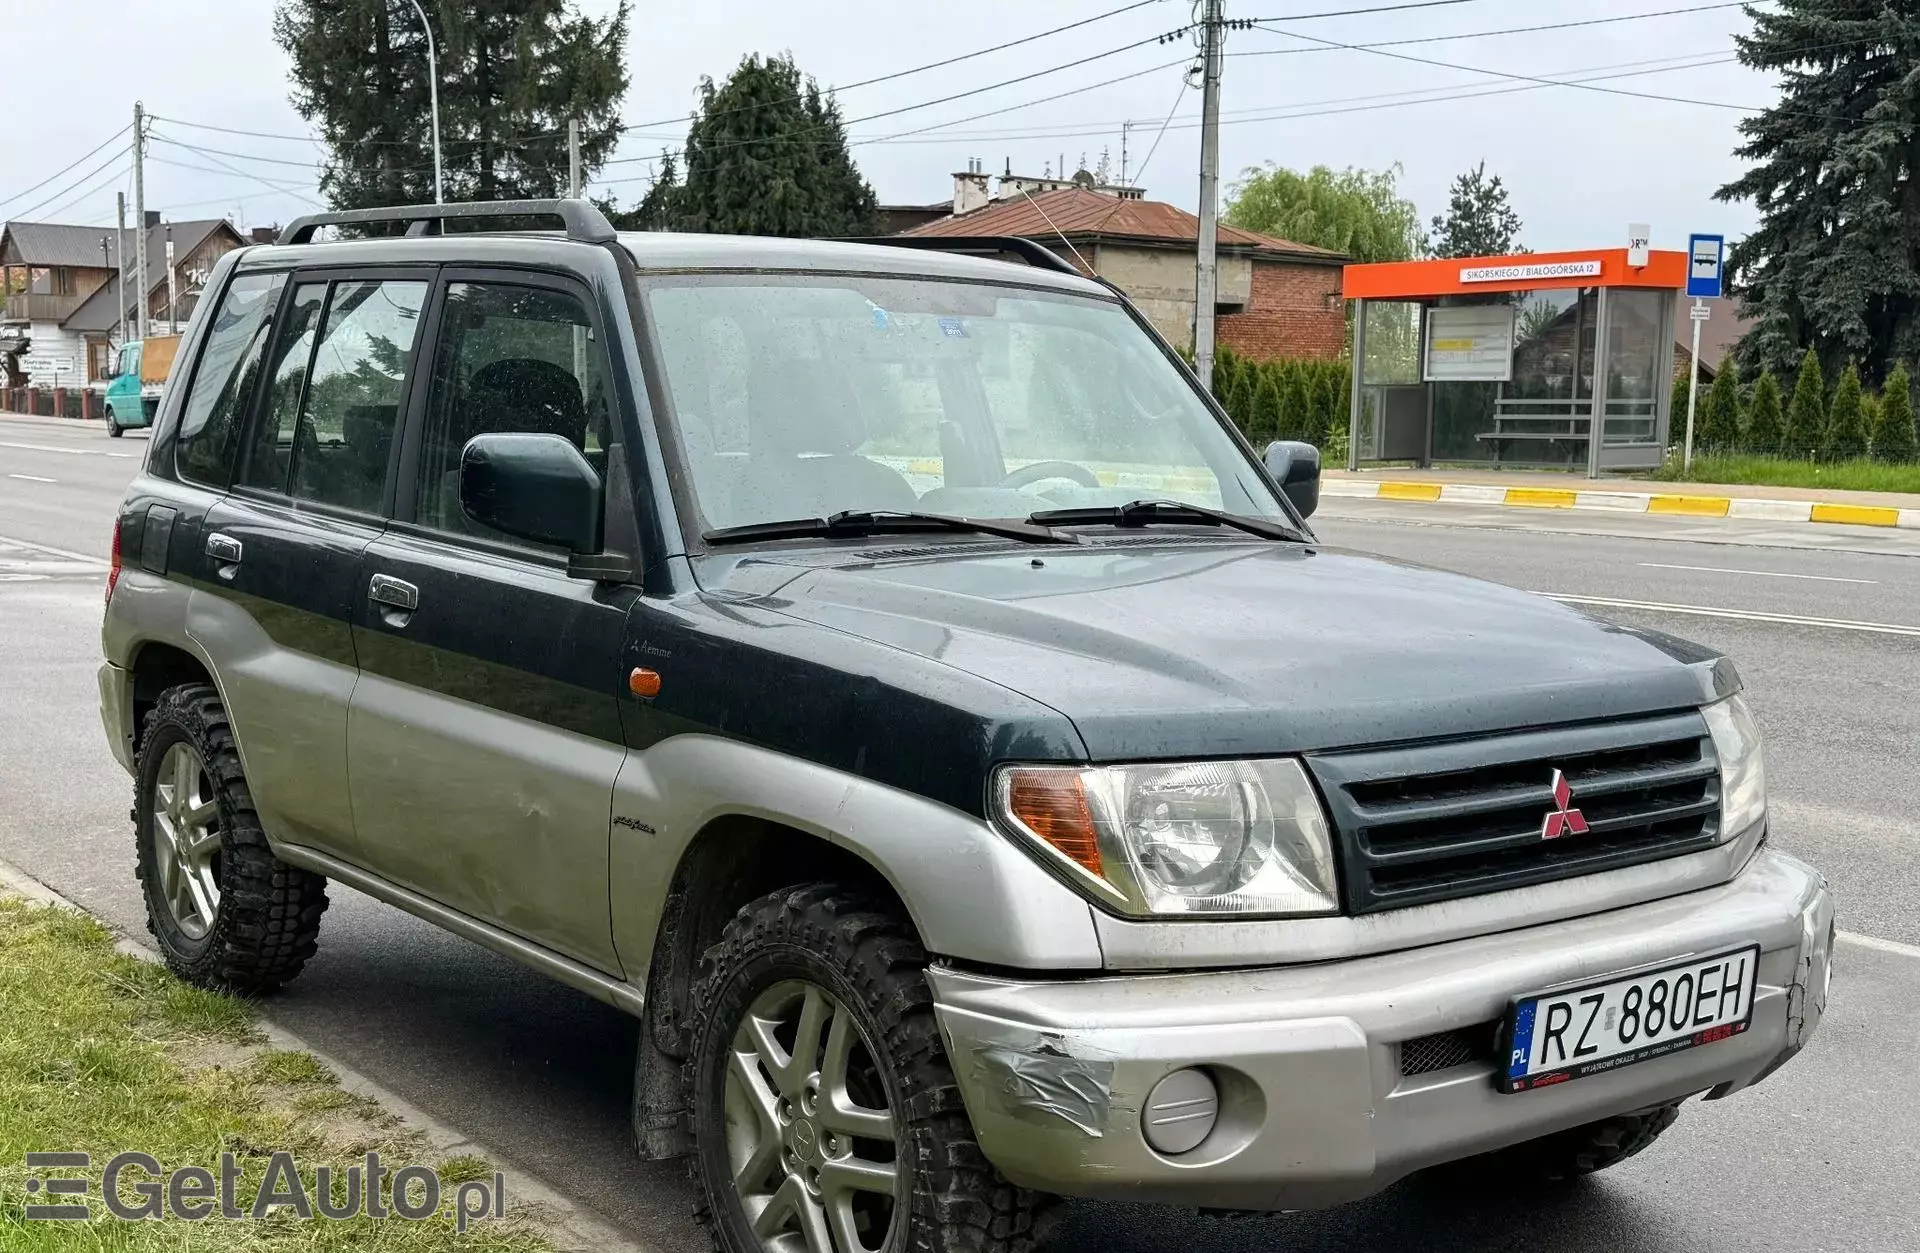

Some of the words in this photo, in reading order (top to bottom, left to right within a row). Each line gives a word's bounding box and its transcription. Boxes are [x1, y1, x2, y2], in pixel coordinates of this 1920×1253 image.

[1467, 268, 1520, 279] SIKORSKIEGO
[1526, 264, 1584, 276] BIAŁOGÓRSKA
[1586, 263, 1594, 272] 12
[1540, 992, 1605, 1065] RZ
[1618, 958, 1745, 1043] 880EH
[1511, 1048, 1527, 1067] PL
